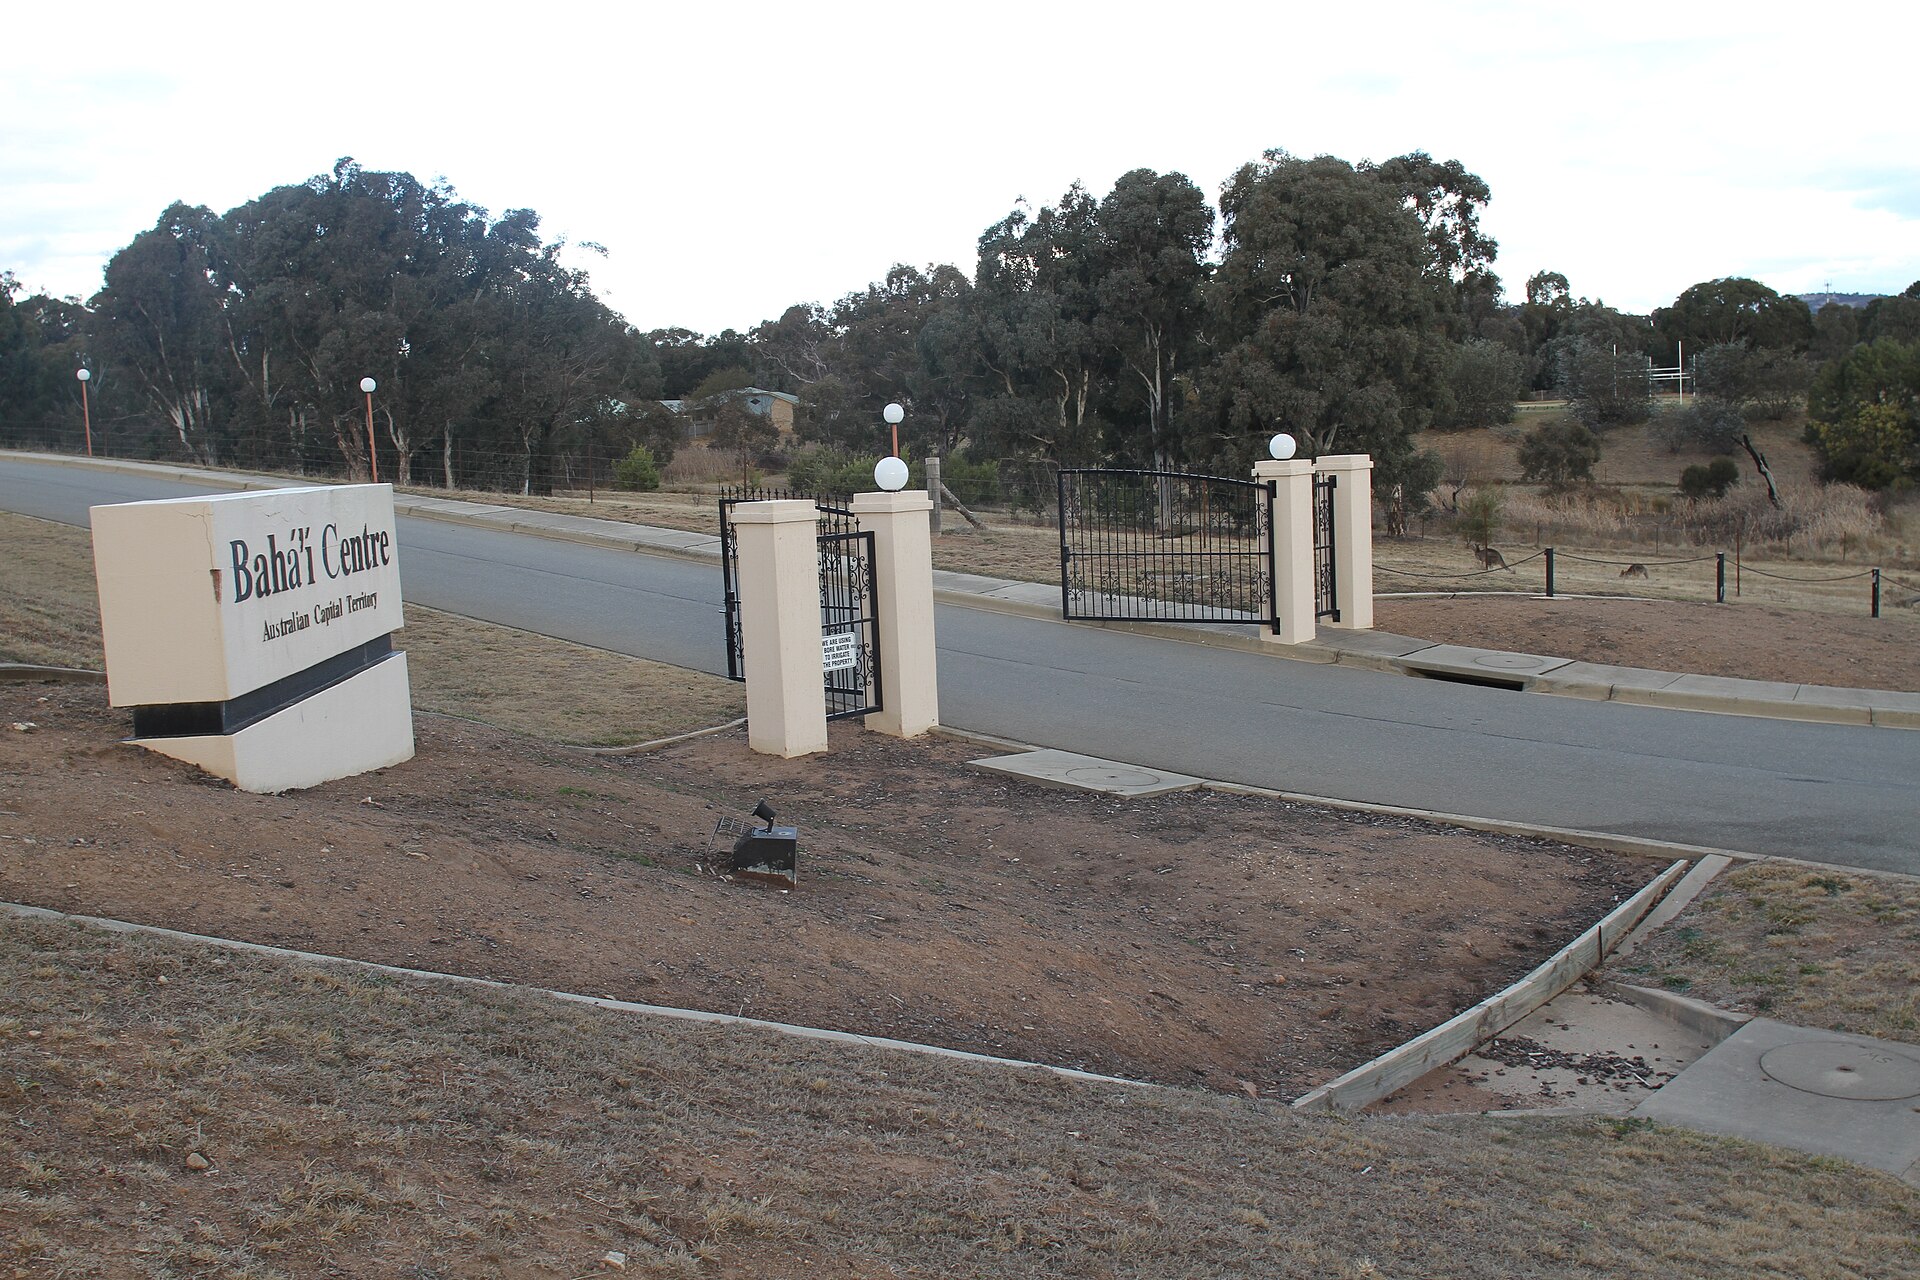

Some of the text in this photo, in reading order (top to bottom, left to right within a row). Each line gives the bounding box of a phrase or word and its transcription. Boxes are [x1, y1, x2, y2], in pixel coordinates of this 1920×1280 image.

[322, 523, 390, 580] Centre
[263, 591, 377, 642] Australian Capital Territory
[831, 651, 849, 659] IRRIGATE
[832, 658, 852, 666] PROPERTY
